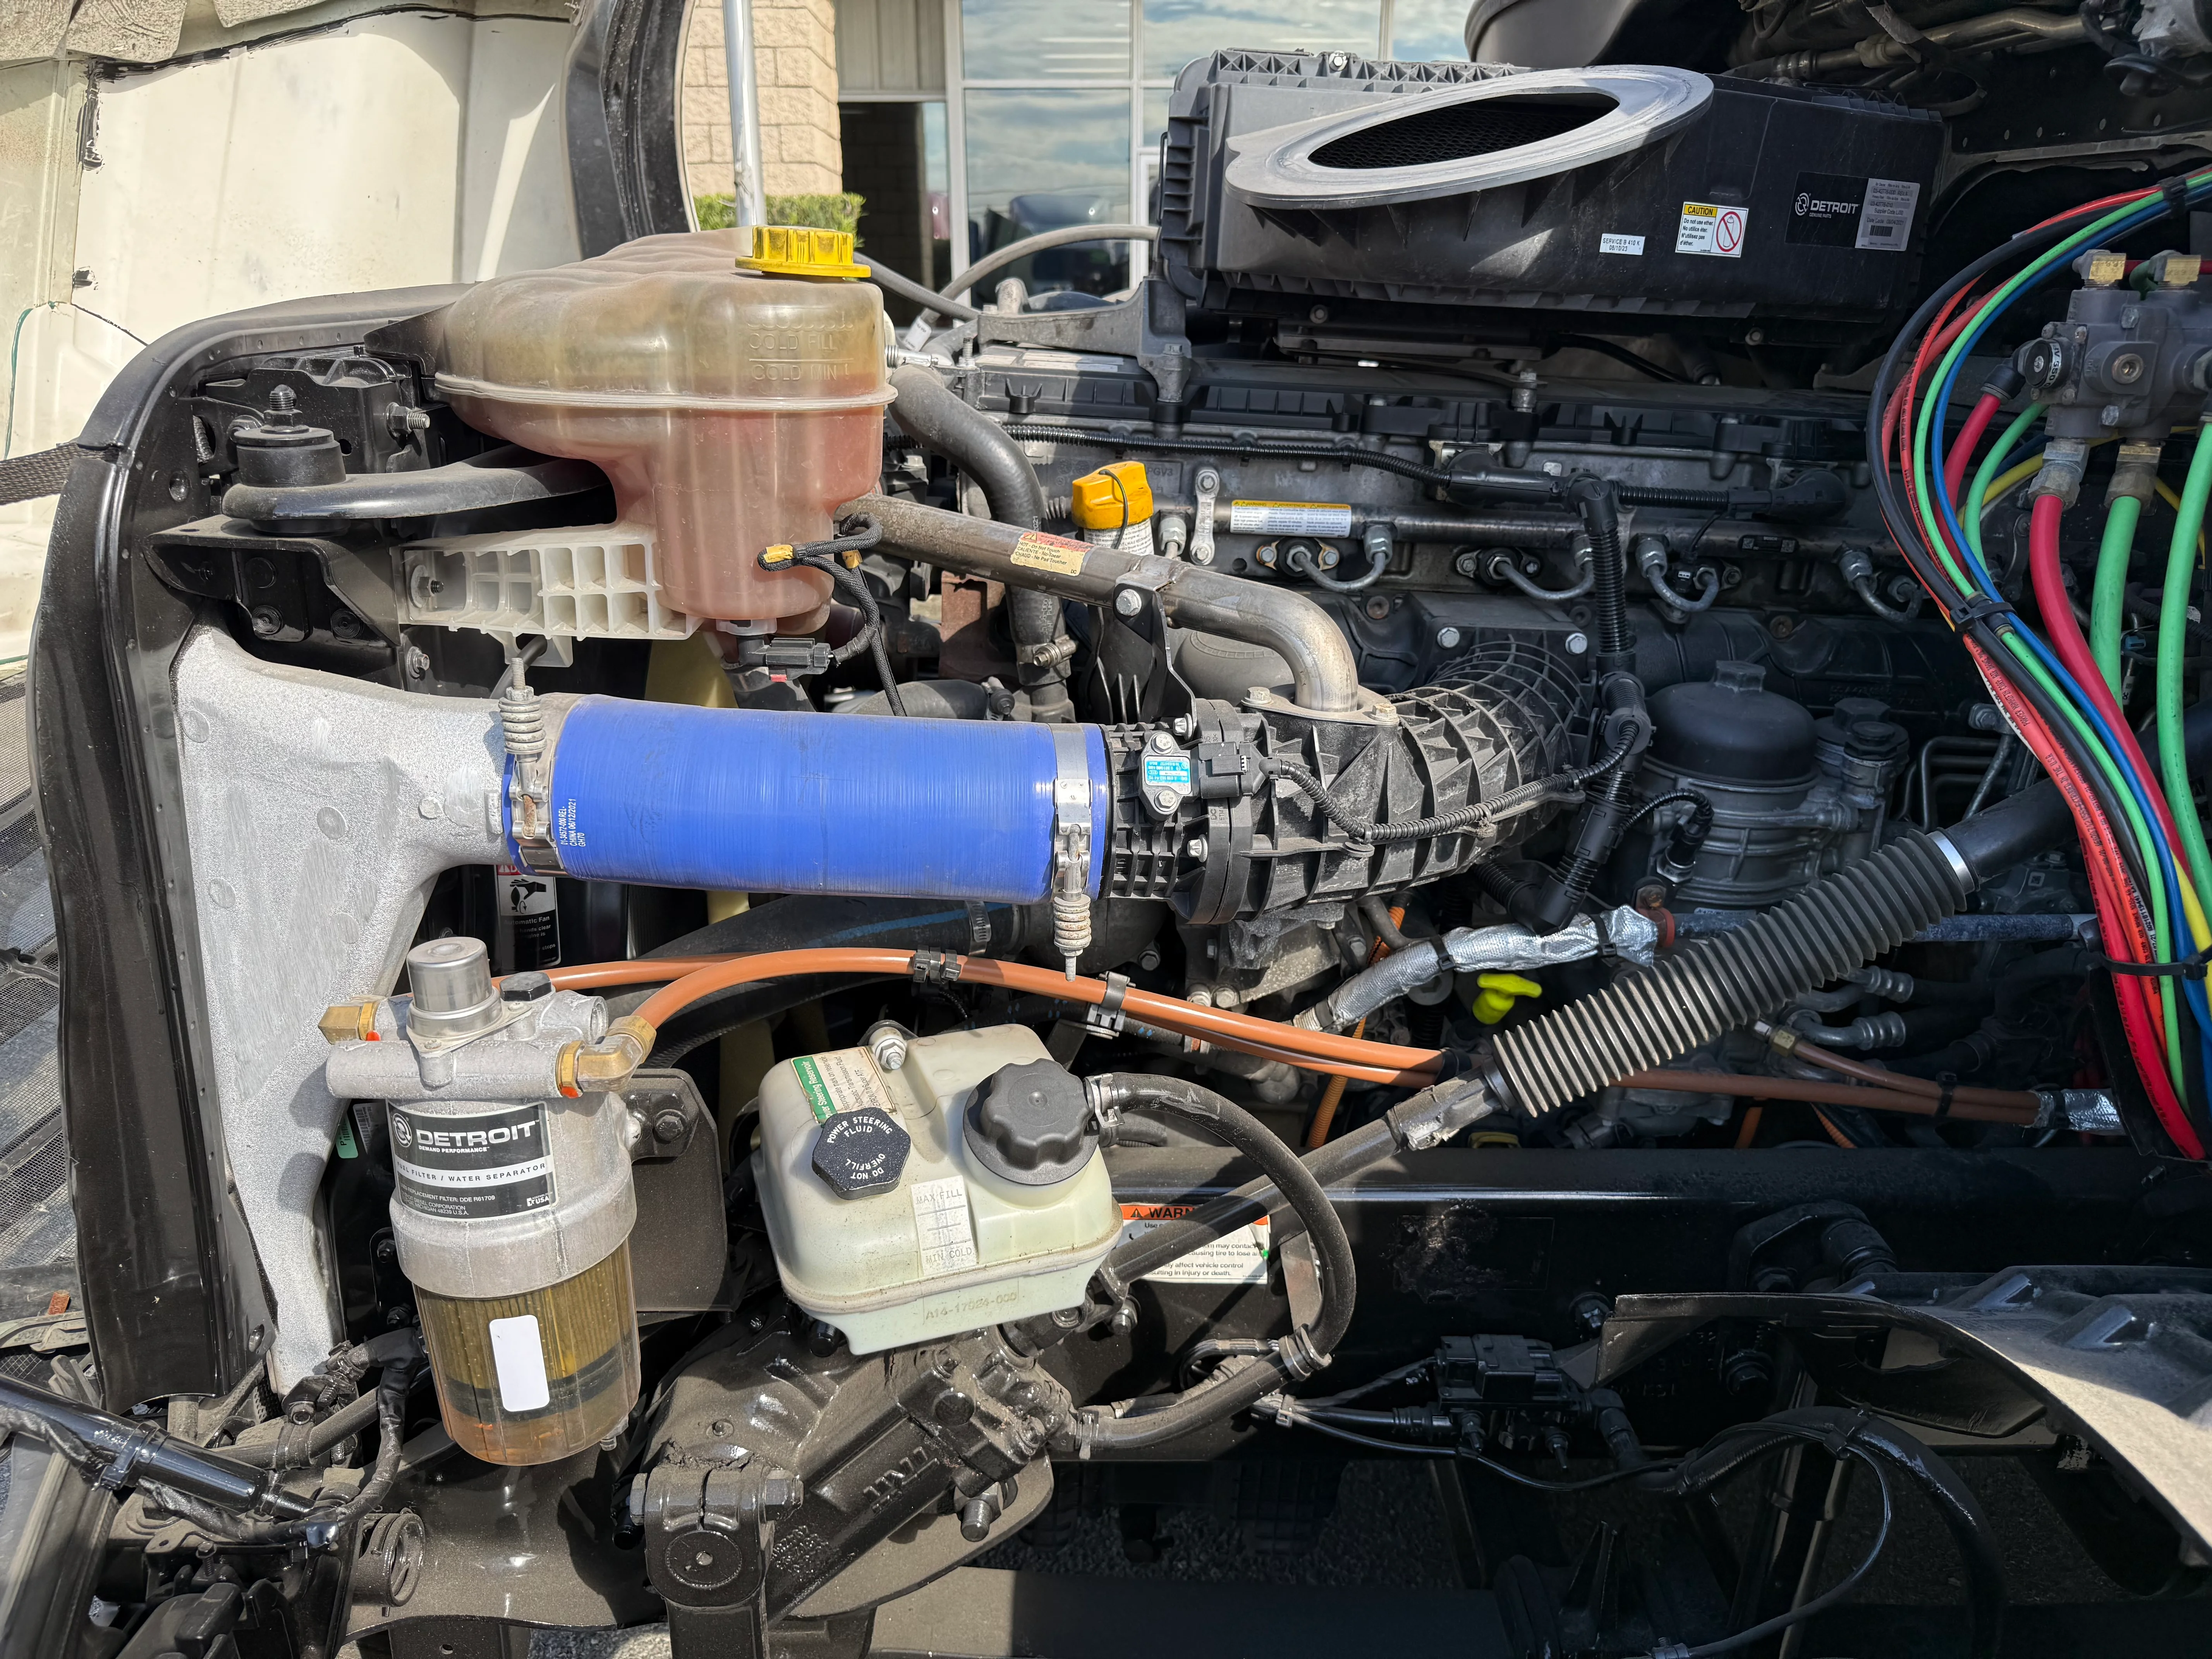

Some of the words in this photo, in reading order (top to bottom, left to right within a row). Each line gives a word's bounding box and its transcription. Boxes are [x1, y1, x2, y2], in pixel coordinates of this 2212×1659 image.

[1688, 206, 1713, 215] CAUTION
[1810, 200, 1859, 214] DETROIT
[749, 333, 799, 349] COLD
[808, 334, 838, 350] FILL
[753, 364, 802, 380] COLD
[811, 365, 837, 380] MIN
[2053, 764, 2064, 776] THE
[568, 799, 576, 829] 06/12/2021
[568, 830, 577, 846] CHINA
[577, 833, 586, 847] GH70
[834, 1056, 843, 1065] Fluid
[801, 1061, 818, 1085] Reservoir
[839, 1063, 855, 1090] Transmission
[813, 1084, 827, 1106] Steering
[851, 1090, 864, 1107] Automatic
[416, 1121, 536, 1147] DETROIT
[827, 1120, 849, 1144] POWER
[853, 1116, 893, 1134] STEERING
[843, 1125, 873, 1137] FLUID
[845, 1153, 886, 1170] OVERFILL
[412, 1170, 436, 1180] FILTER
[486, 1163, 546, 1180] SEPARATOR
[872, 1167, 884, 1177] DO
[408, 1187, 438, 1200] REPLACEMENT
[536, 1195, 550, 1204] USA
[916, 1194, 936, 1204] MAX
[940, 1189, 963, 1199] FILL
[428, 1202, 465, 1210] CORPORATION
[926, 1253, 943, 1265] MIN
[949, 1247, 972, 1259] COLD
